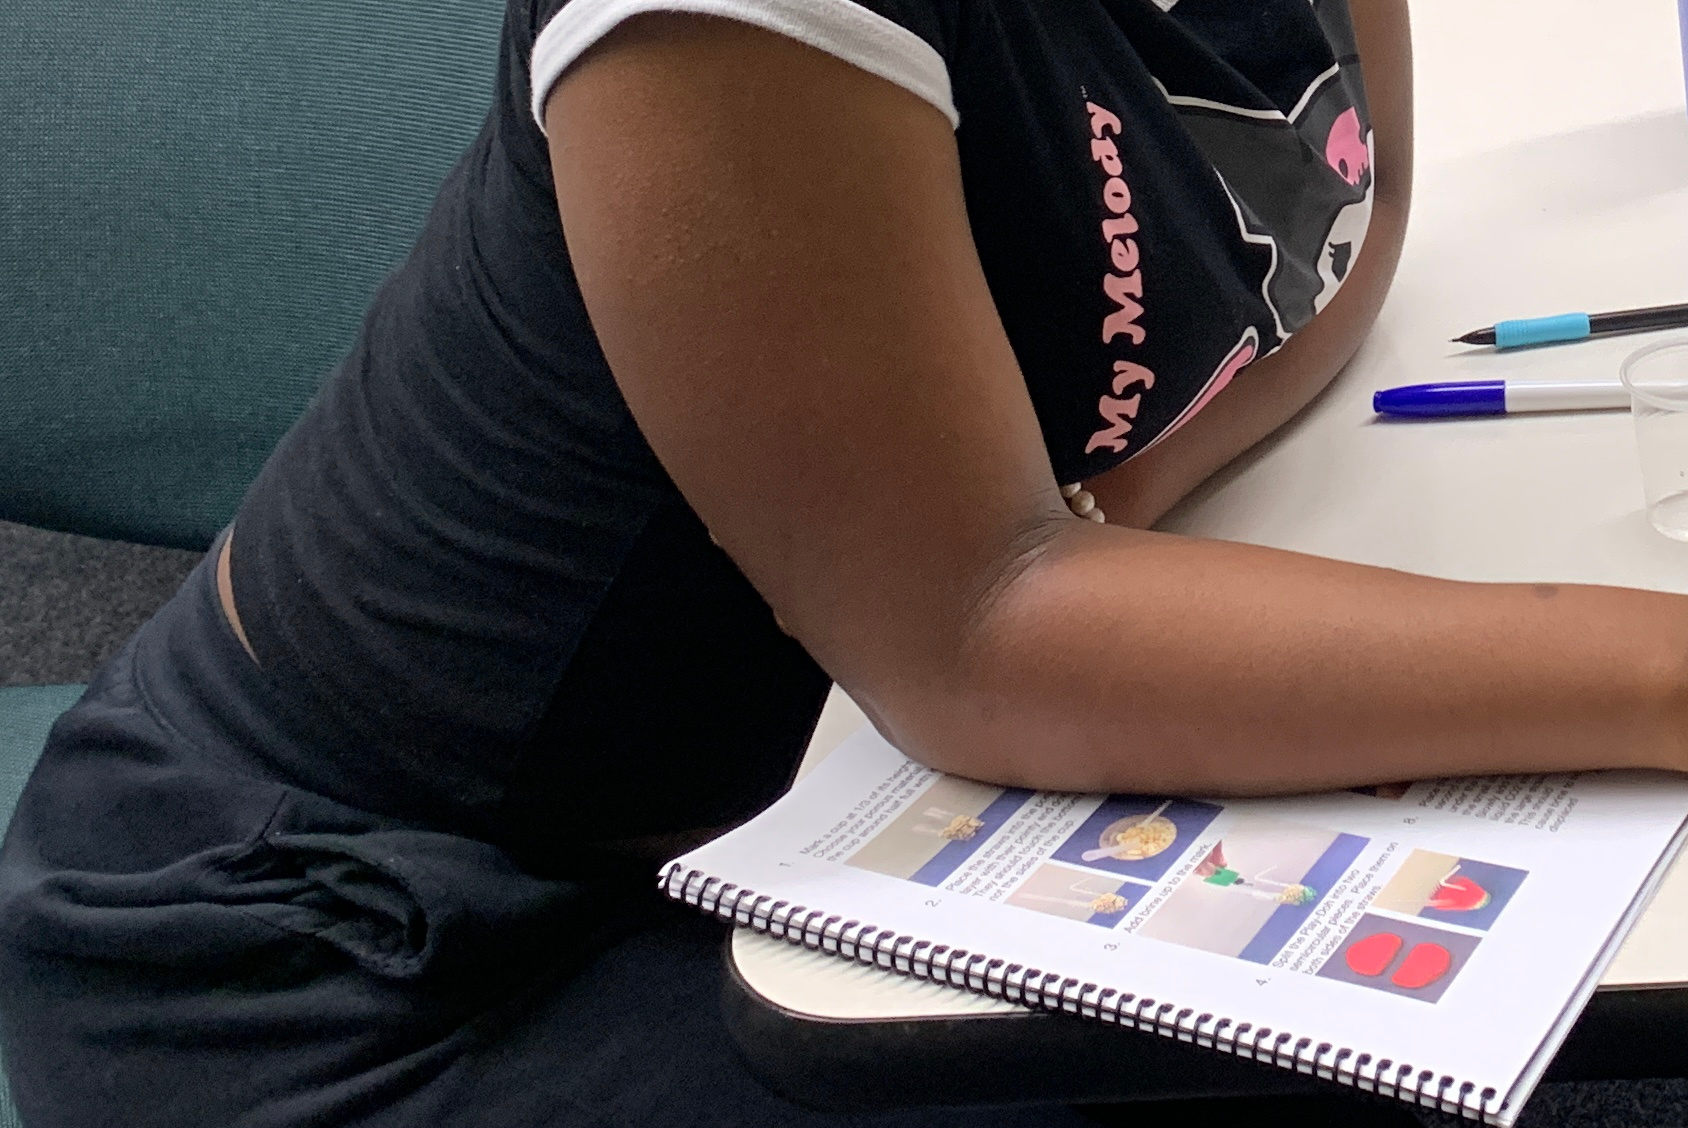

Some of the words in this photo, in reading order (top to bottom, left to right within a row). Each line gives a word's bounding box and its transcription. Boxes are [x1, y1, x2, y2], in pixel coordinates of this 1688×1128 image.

[1086, 101, 1146, 344] Melody
[1085, 360, 1151, 454] My
[830, 820, 848, 833] cup
[846, 812, 857, 820] at
[854, 800, 871, 811] 1/3
[869, 791, 880, 800] of
[842, 838, 860, 851] cup
[859, 814, 888, 837] around
[884, 800, 903, 814] half
[846, 818, 865, 834] your
[864, 795, 893, 819] porous
[959, 877, 982, 894] layer
[980, 862, 999, 876] with
[995, 844, 1016, 860] their
[1014, 822, 1040, 844] pointy
[1038, 807, 1054, 821] end
[924, 898, 943, 908] 2.
[945, 872, 972, 891] Place
[968, 859, 985, 871] the
[983, 835, 1010, 858] straws
[1007, 821, 1024, 834] into
[1021, 808, 1037, 819] the
[972, 880, 998, 896] They
[994, 855, 1022, 879] should
[1018, 834, 1043, 854] touch
[1040, 822, 1056, 833] the
[989, 889, 1005, 901] not
[1001, 876, 1018, 888] the
[1016, 856, 1038, 876] sides
[1036, 846, 1047, 855] of
[1043, 835, 1060, 846] the
[1103, 942, 1121, 952] 3.
[1124, 916, 1144, 933] Add
[1138, 897, 1162, 916] brine
[1159, 886, 1172, 896] up
[1167, 877, 1181, 885] to
[1176, 864, 1193, 876] the
[1255, 976, 1272, 987] 4.
[1272, 950, 1294, 968] Split
[1288, 936, 1305, 949] the
[1300, 900, 1334, 936] Play-Doh
[1330, 884, 1347, 899] into
[1342, 869, 1360, 883] two
[1290, 926, 1331, 971] semicircular
[1350, 873, 1374, 894] Place
[1369, 853, 1390, 872] them
[1386, 842, 1398, 852] on
[1302, 957, 1324, 975] both
[1320, 935, 1342, 955] sides
[1338, 924, 1349, 934] of
[1344, 911, 1360, 924] the
